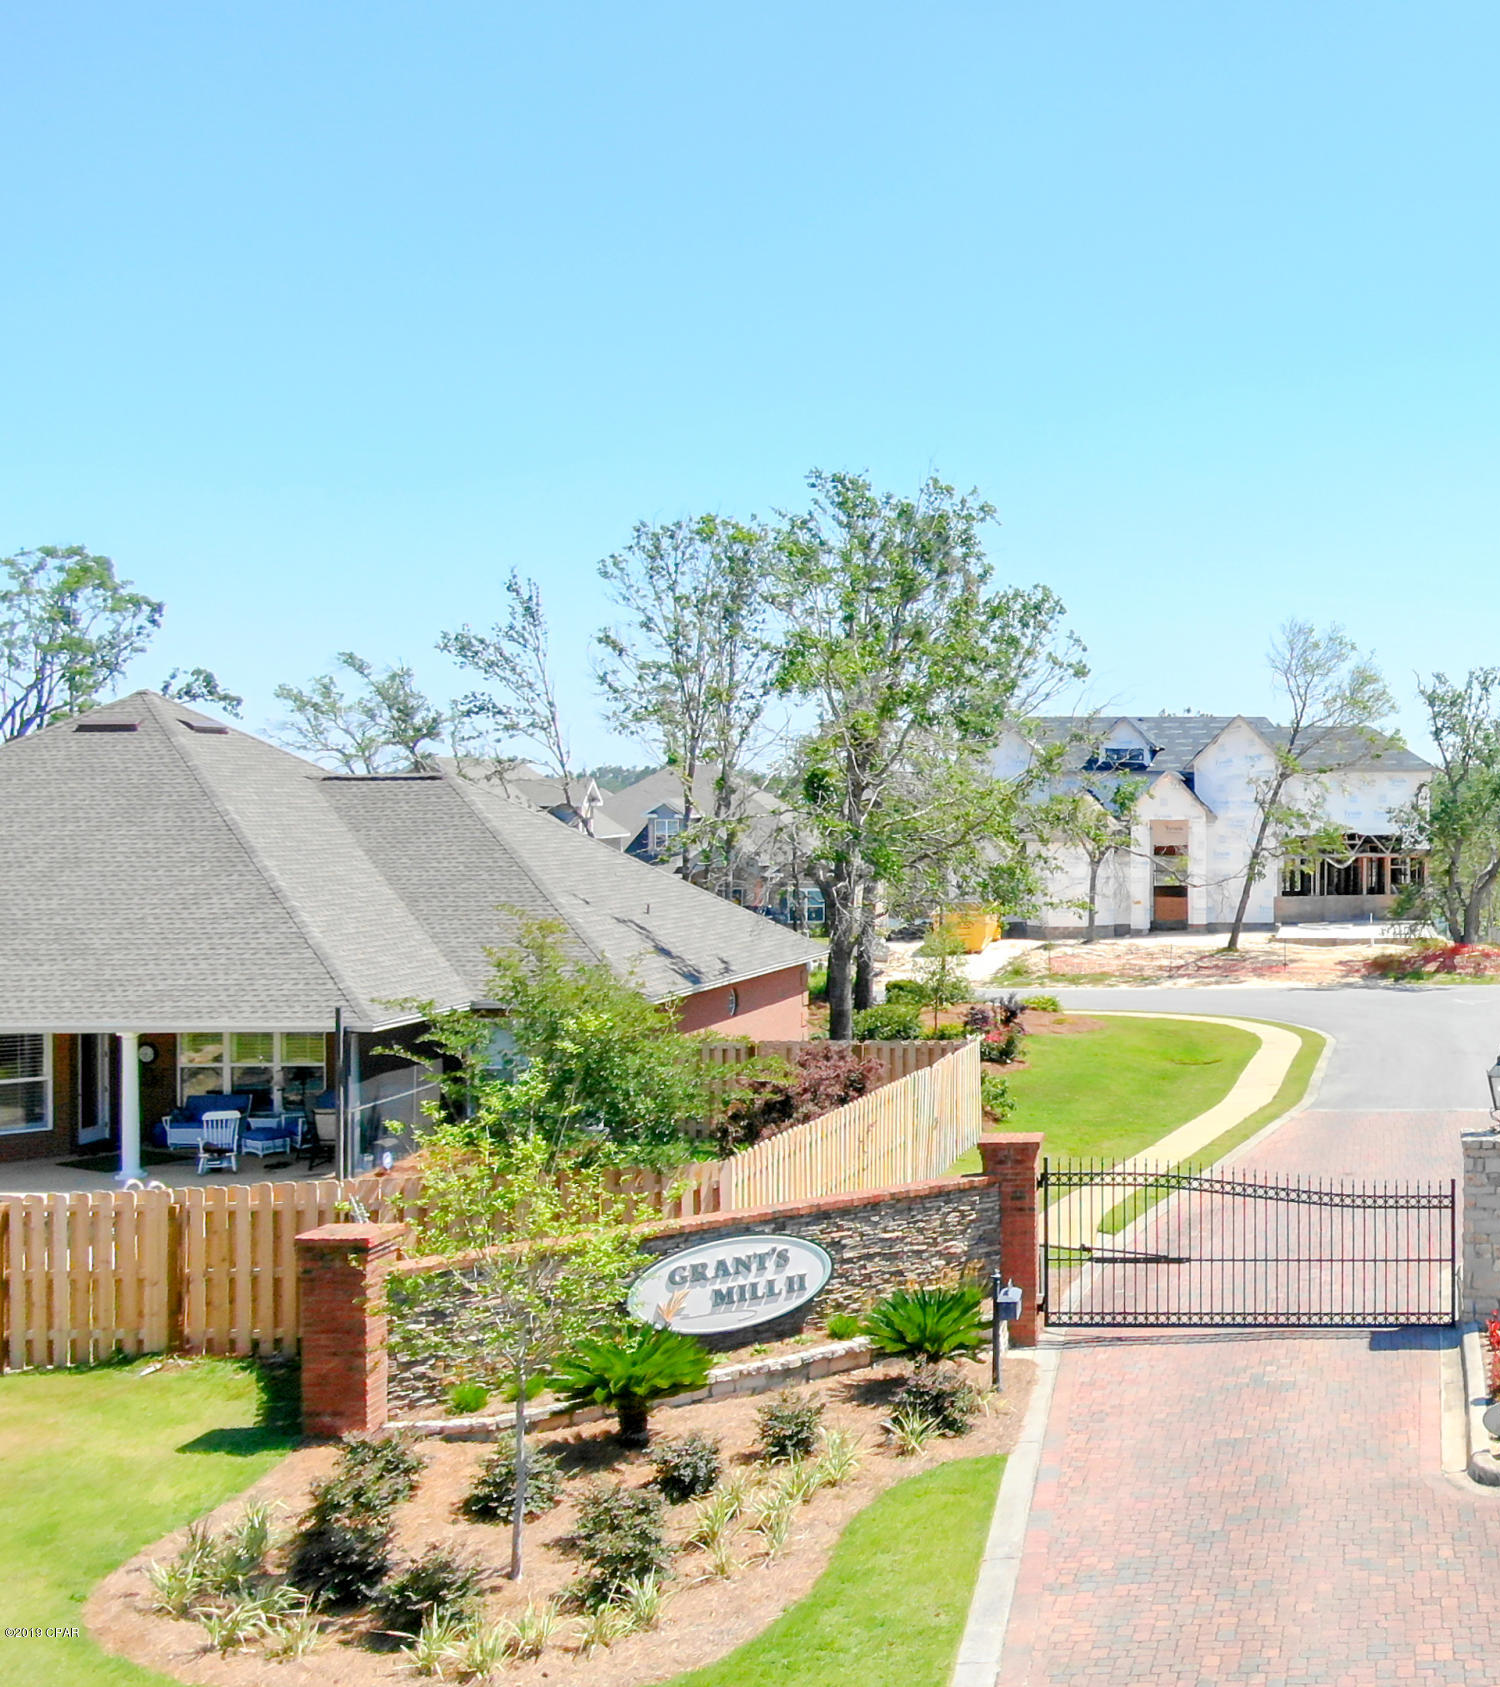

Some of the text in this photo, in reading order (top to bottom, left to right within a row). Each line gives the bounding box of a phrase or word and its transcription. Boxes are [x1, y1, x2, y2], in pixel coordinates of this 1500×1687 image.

[668, 1246, 790, 1286] GRANT'S
[712, 1273, 808, 1307] MILL II
